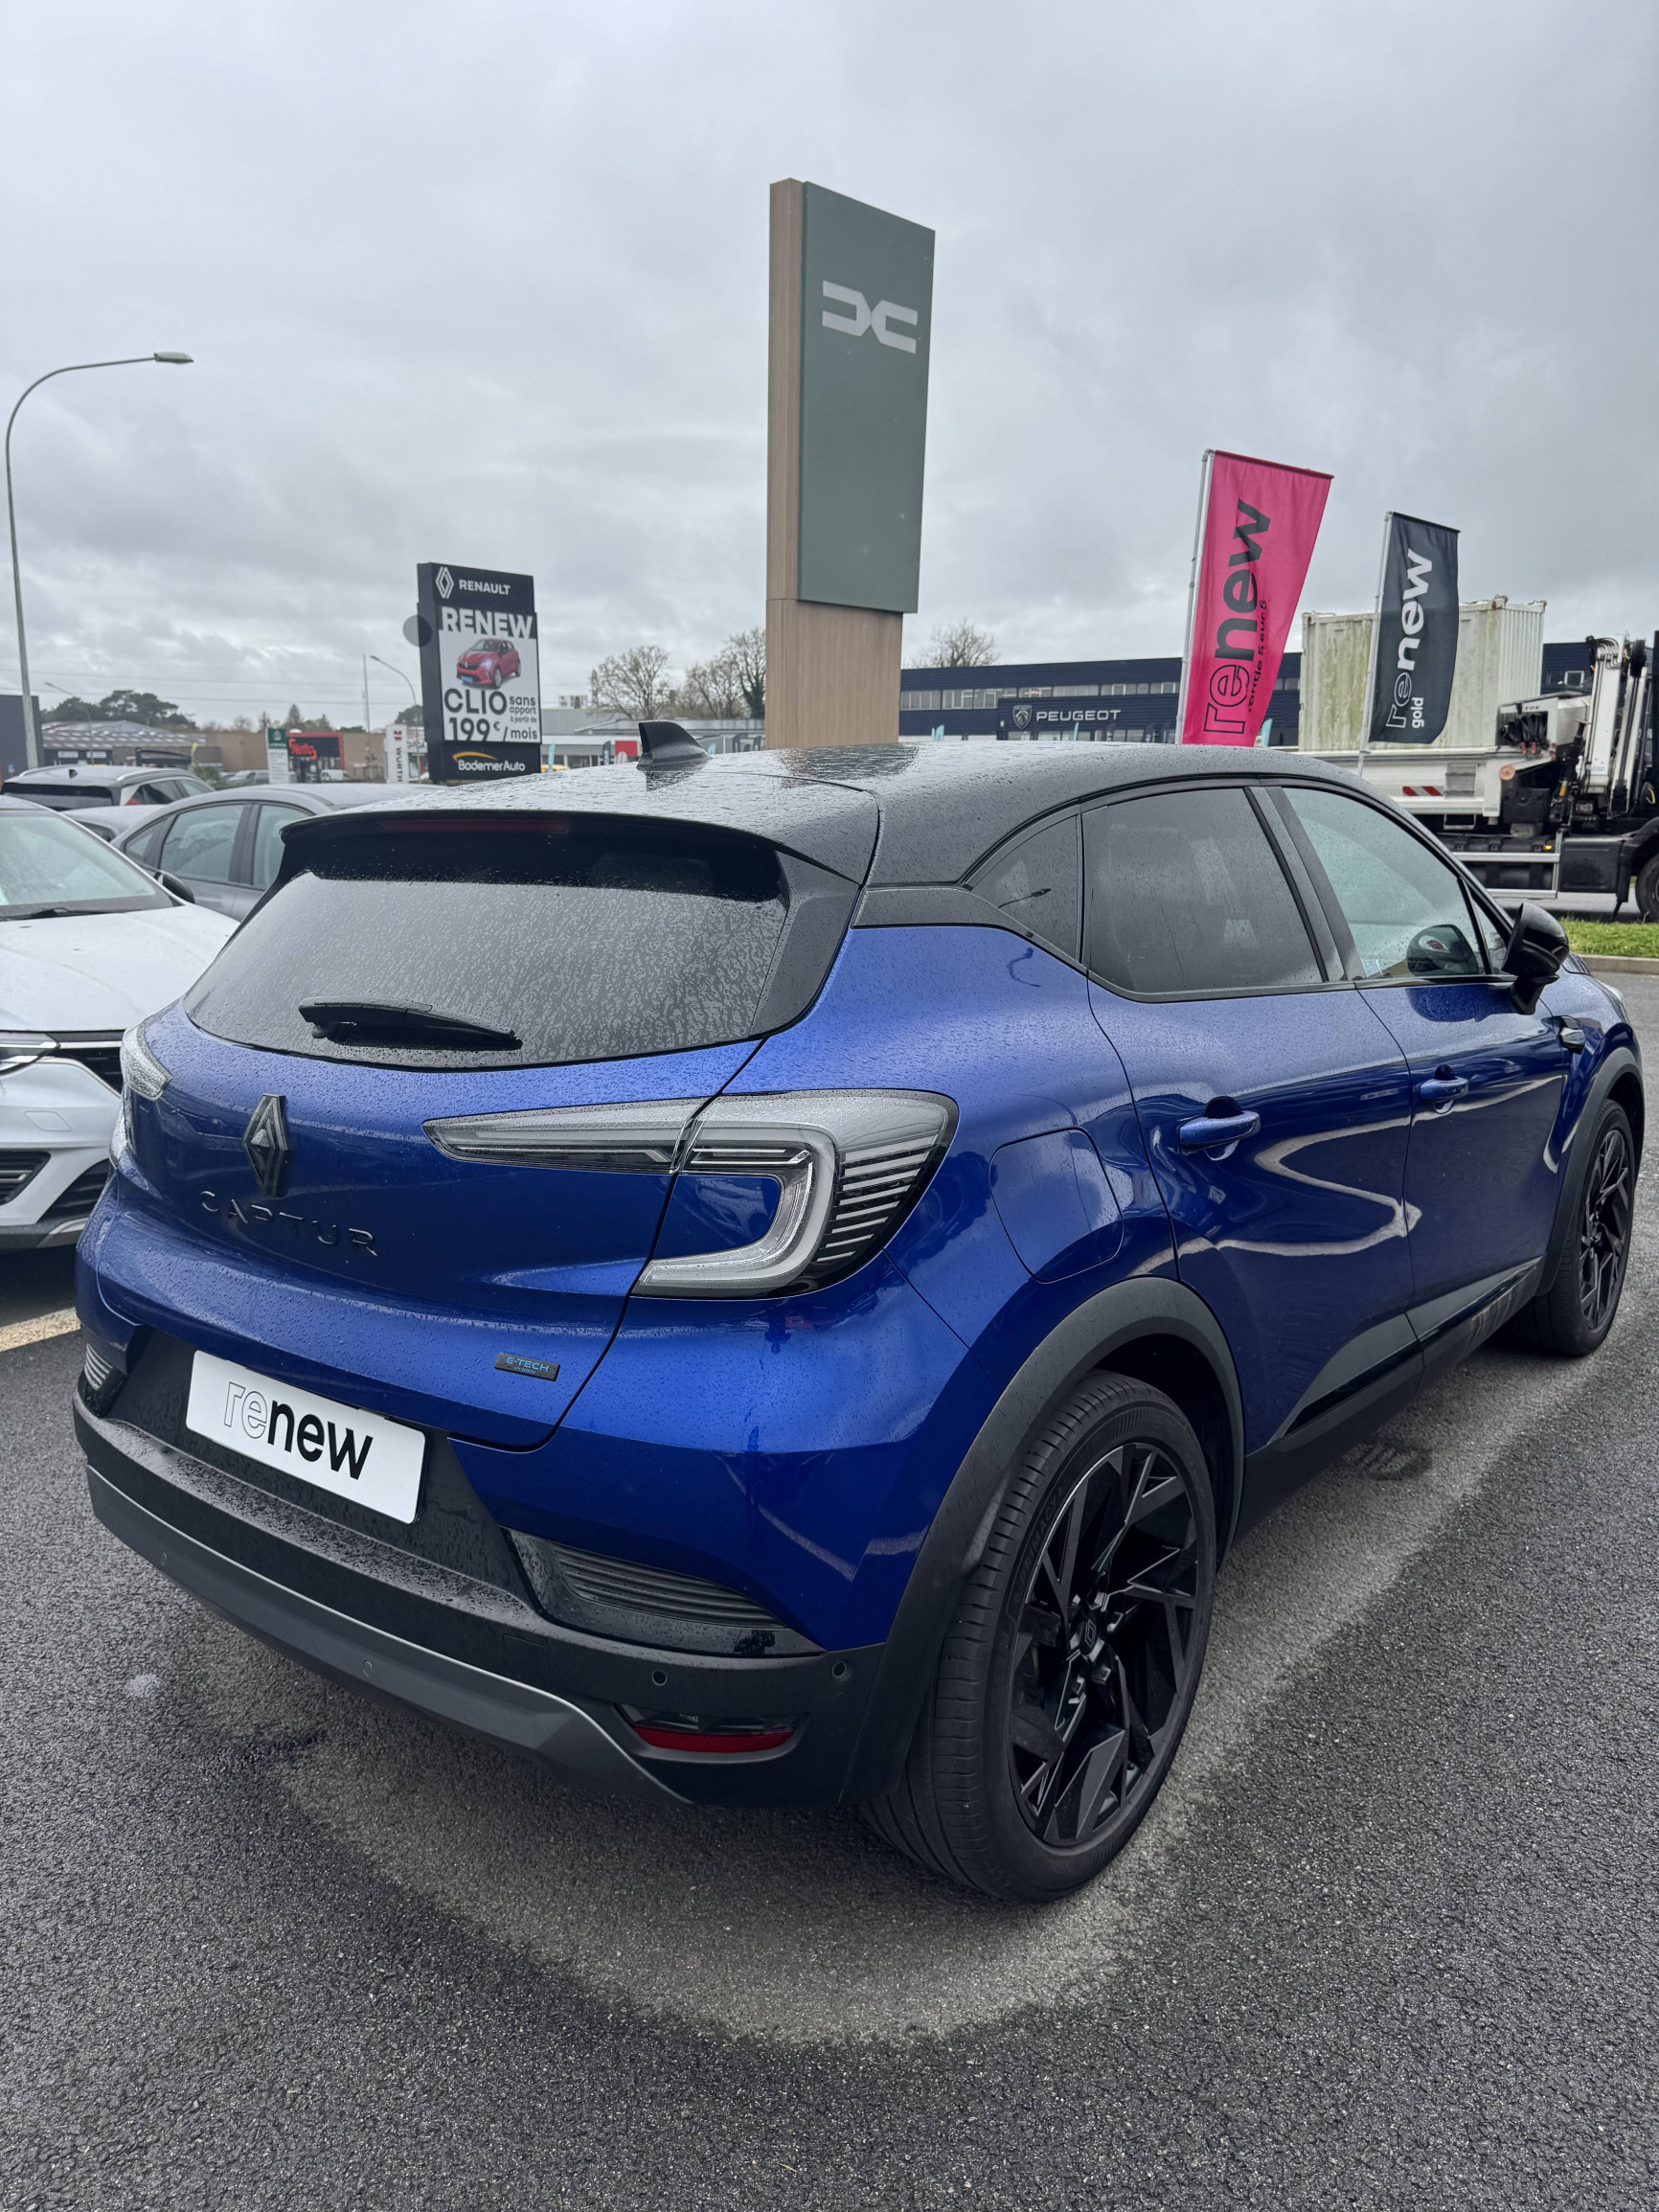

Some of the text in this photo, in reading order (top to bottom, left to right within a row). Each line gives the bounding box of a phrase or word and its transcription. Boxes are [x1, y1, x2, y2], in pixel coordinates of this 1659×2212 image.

[459, 580, 511, 595] RENAULT
[442, 606, 533, 638] RENEW
[1203, 498, 1271, 734] renew
[1385, 548, 1432, 728] renew
[444, 688, 507, 716] CLIO
[510, 696, 535, 706] sans
[510, 706, 536, 716] apport
[1035, 710, 1122, 721] PEUGEOT
[1411, 697, 1424, 729] gold
[200, 1191, 378, 1256] CAPTUR
[506, 1357, 550, 1372] E-TECH
[224, 1381, 374, 1480] renew
